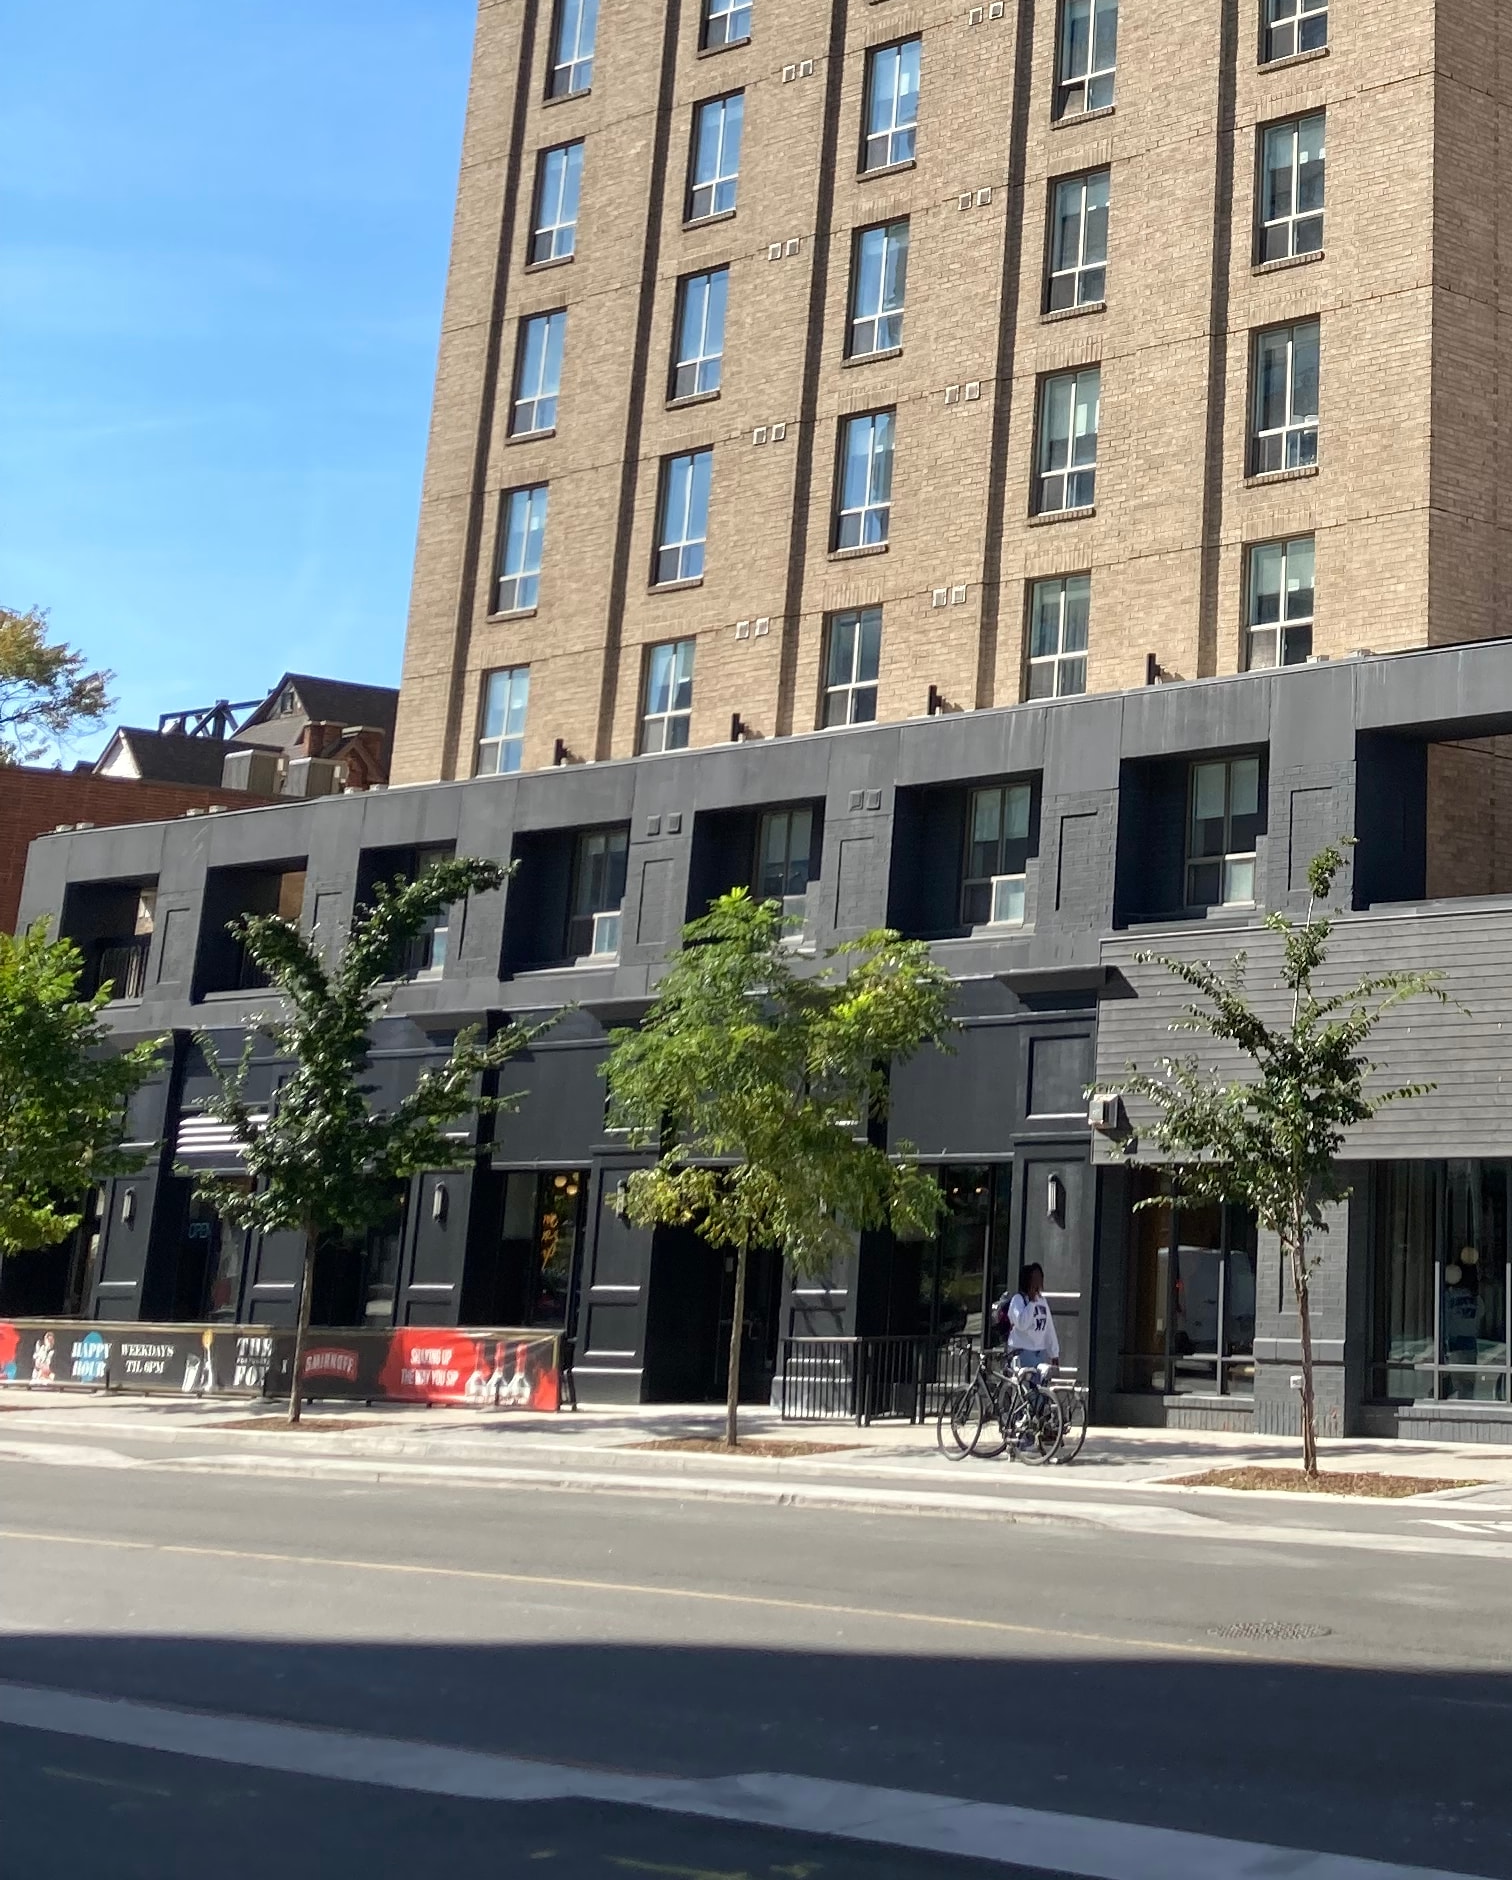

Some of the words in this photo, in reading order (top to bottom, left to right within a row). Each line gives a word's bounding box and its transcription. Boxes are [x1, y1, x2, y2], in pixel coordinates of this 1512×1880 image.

[71, 1342, 112, 1359] HAPPY
[121, 1344, 175, 1358] WEEKDAYS
[236, 1337, 273, 1356] THE
[72, 1360, 106, 1377] HOUR
[143, 1360, 164, 1374] 6PM
[305, 1352, 354, 1372] SMIRNOFF
[233, 1365, 270, 1387] FOX
[431, 1369, 446, 1386] YOU
